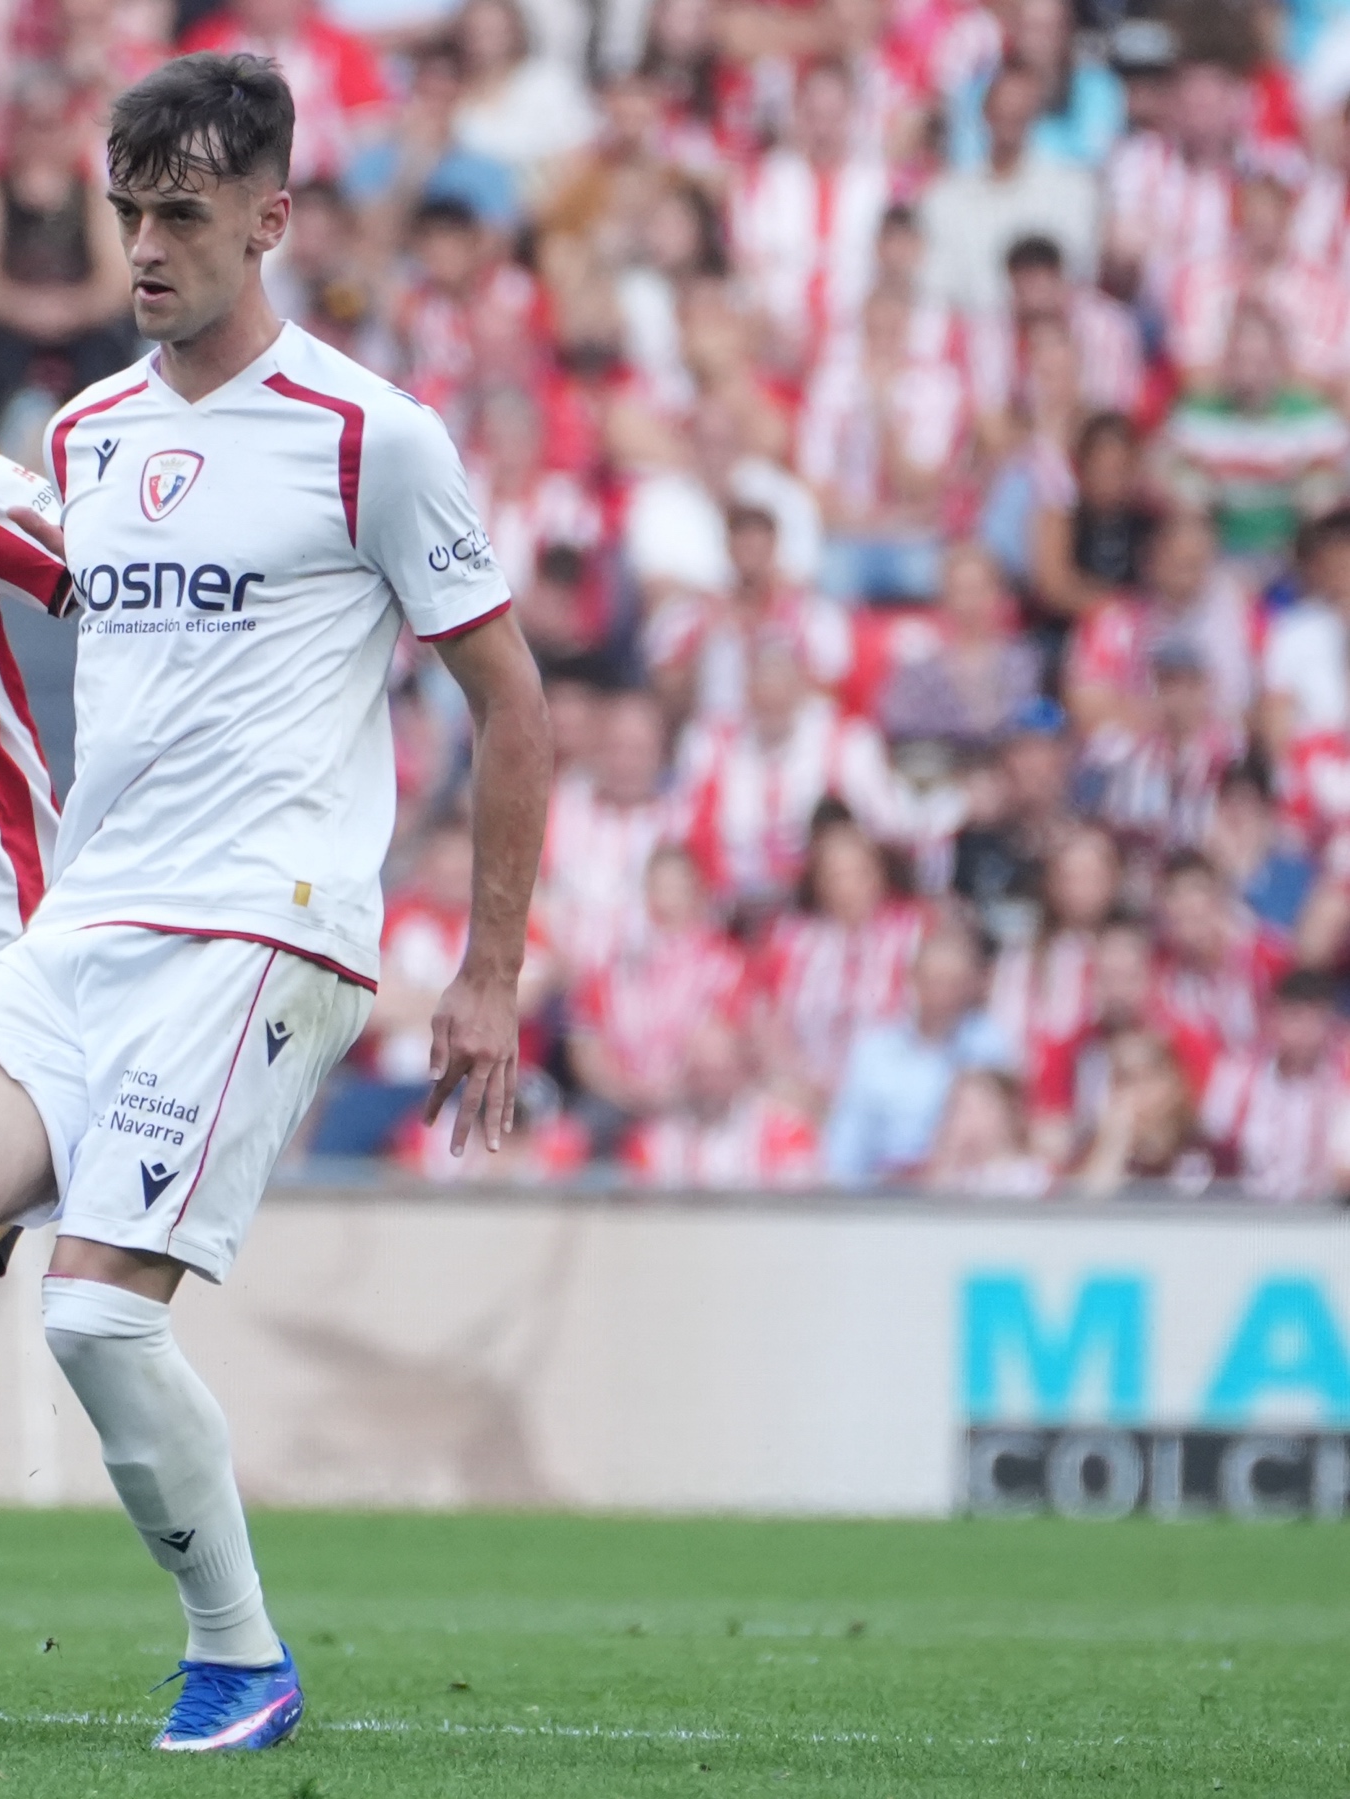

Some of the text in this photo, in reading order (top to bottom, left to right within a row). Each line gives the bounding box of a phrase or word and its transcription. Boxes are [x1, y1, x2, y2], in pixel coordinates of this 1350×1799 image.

[96, 618, 257, 635] Climatización eficiente
[110, 1110, 185, 1146] Navarra
